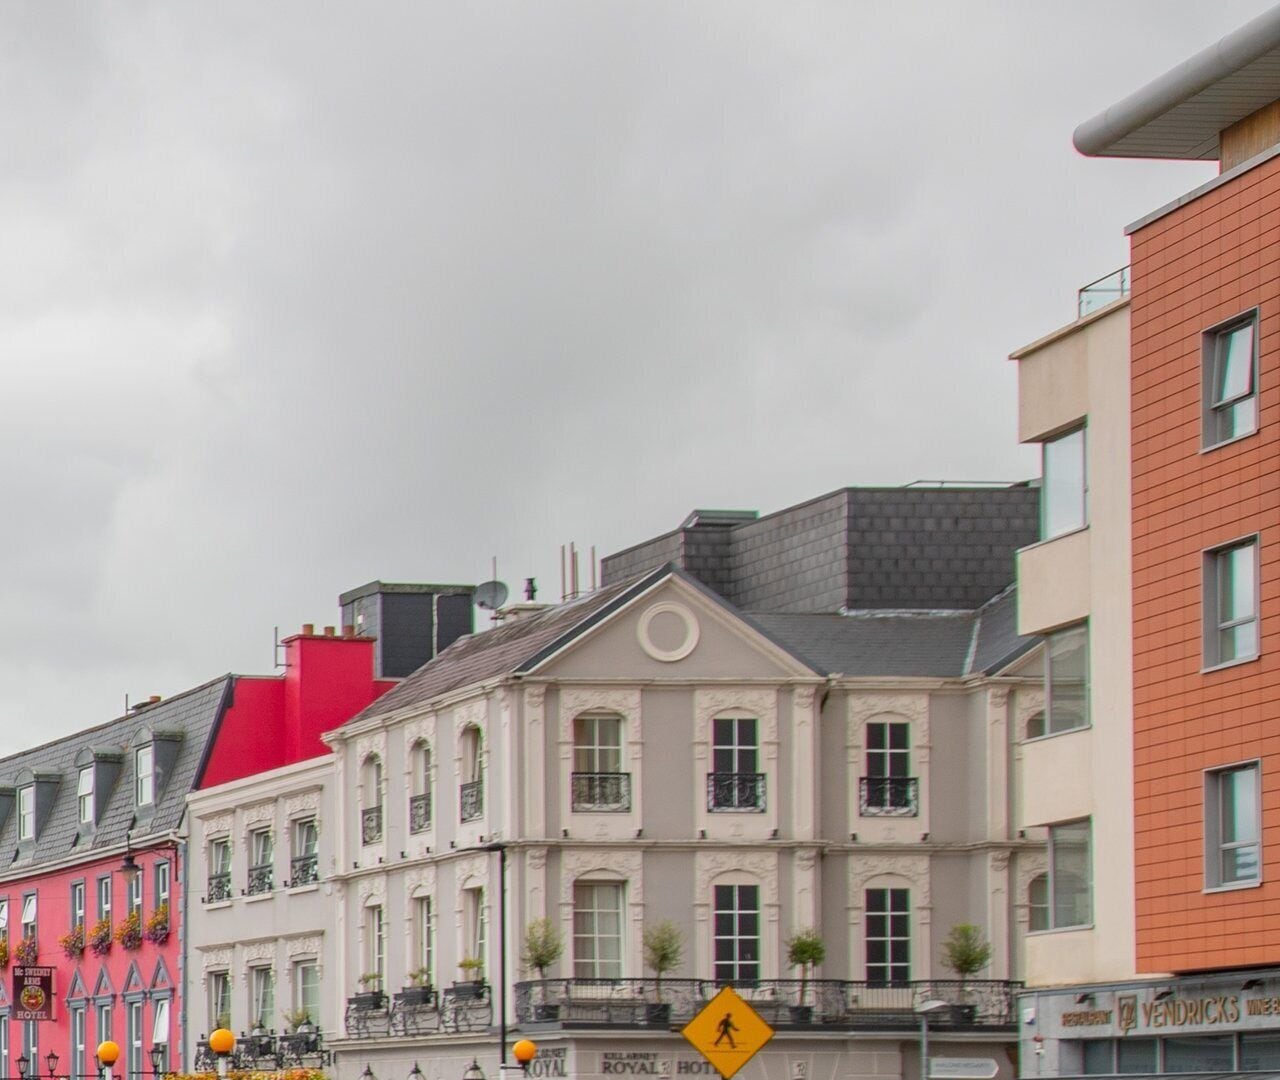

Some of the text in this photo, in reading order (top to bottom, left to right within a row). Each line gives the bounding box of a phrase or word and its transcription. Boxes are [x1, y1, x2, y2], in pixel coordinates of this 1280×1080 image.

[17, 1010, 48, 1019] HOTEL
[1142, 996, 1239, 1028] VENDRICKS
[603, 1052, 660, 1061] KILLARNEY
[602, 1061, 720, 1074] ROYAL HOT
